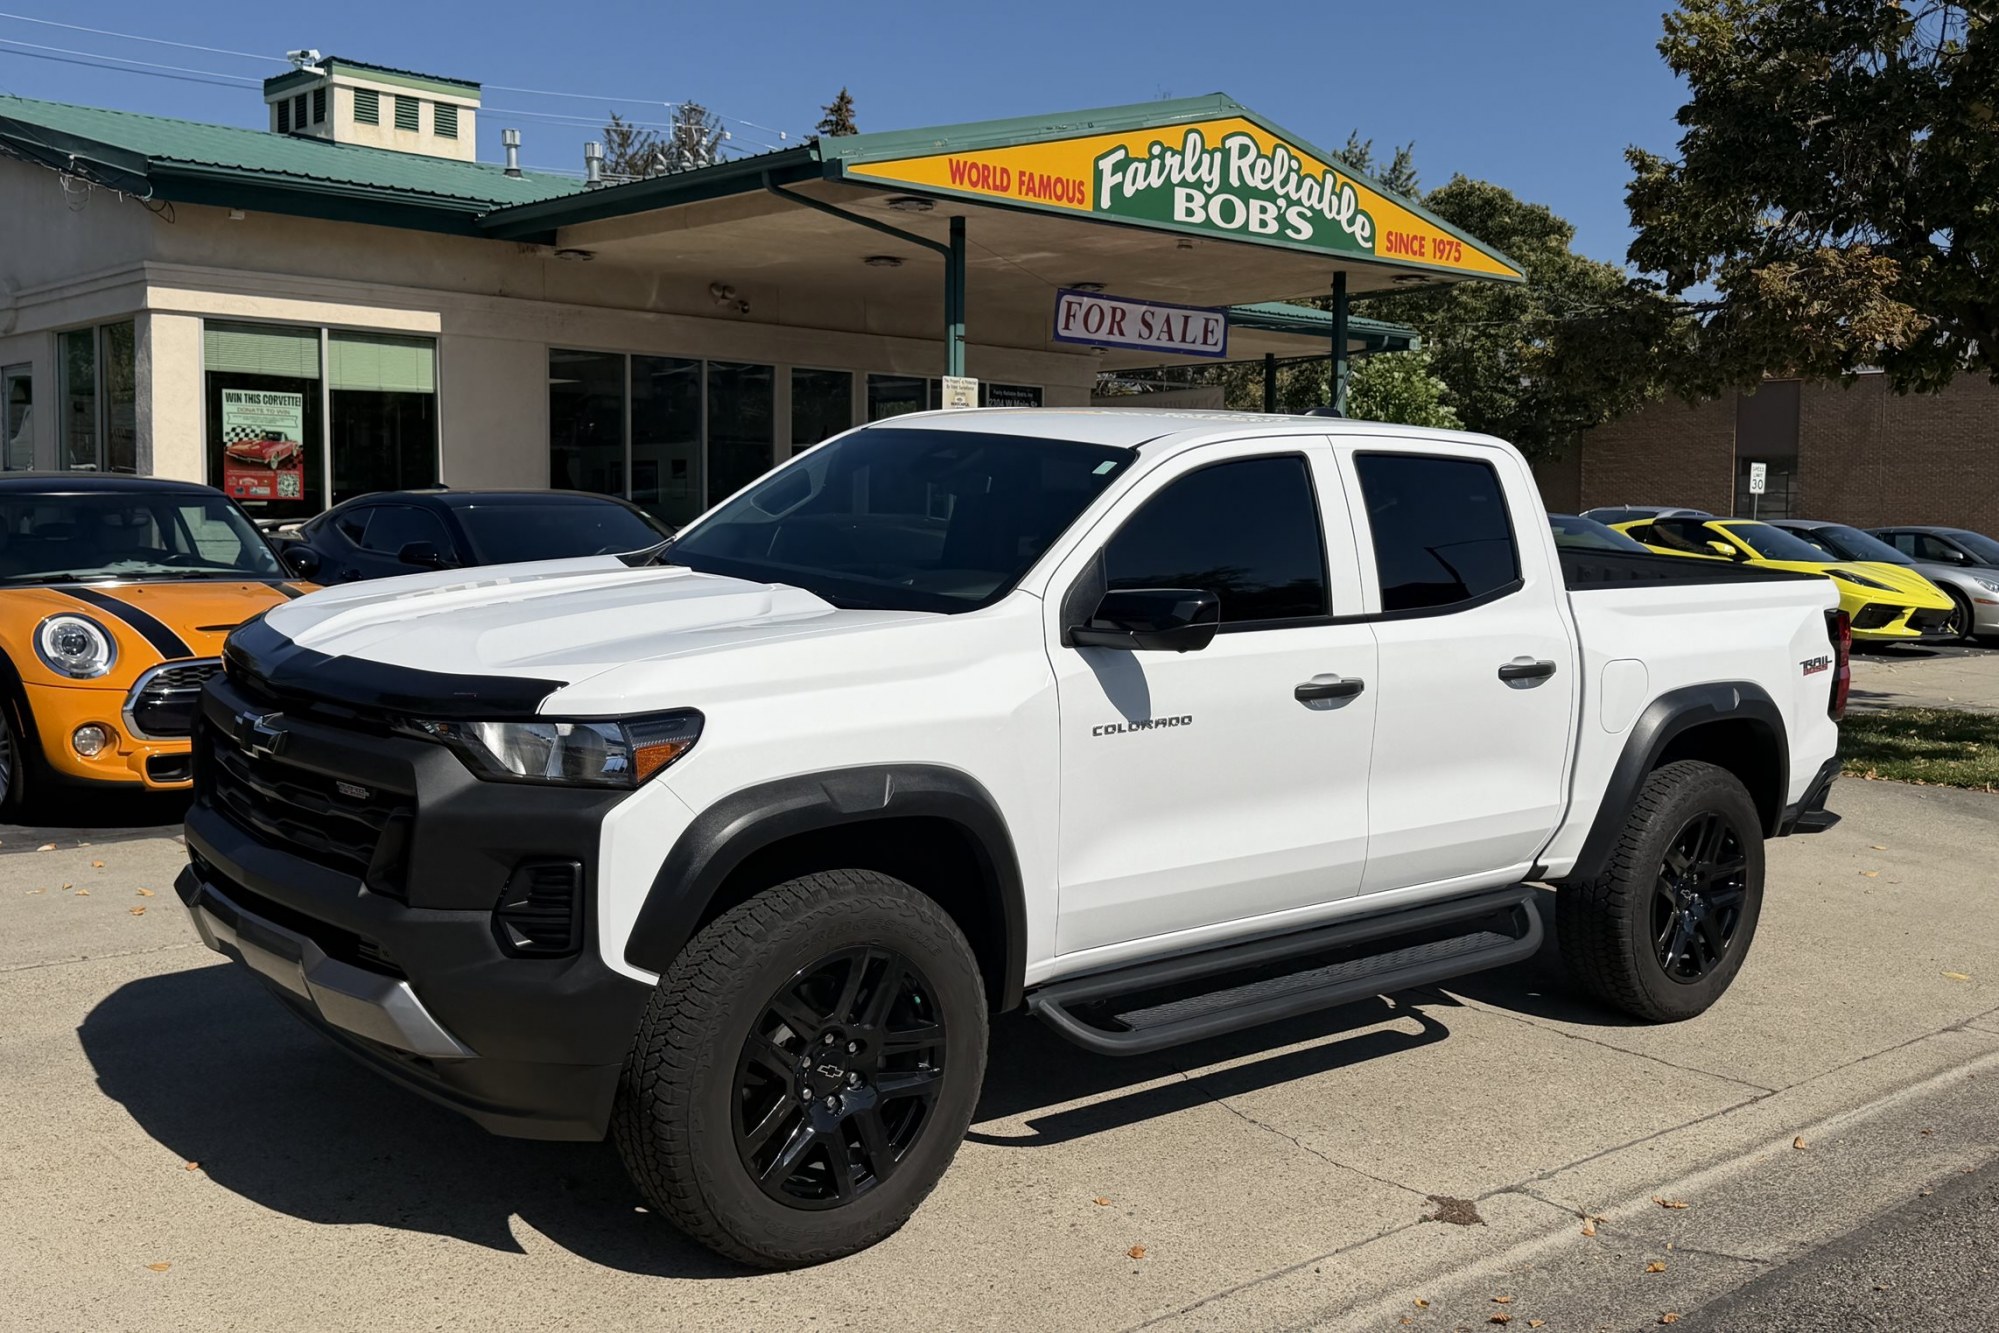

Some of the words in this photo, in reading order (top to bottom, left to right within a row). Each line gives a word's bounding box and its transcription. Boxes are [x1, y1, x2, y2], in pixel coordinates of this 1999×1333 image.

[948, 158, 1011, 193] WORLD
[1018, 170, 1086, 205] FAMOUS
[1098, 132, 1222, 209] Fairly
[1225, 135, 1373, 248] Reliable
[1174, 186, 1314, 240] BOB'S
[1385, 230, 1426, 257] SINCE
[1432, 237, 1462, 263] 1975
[1062, 300, 1127, 337] FOR
[1138, 309, 1219, 347] SALE
[225, 392, 242, 404] WIN
[244, 393, 261, 405] THIS
[262, 394, 302, 407] CORVETTE!
[1751, 479, 1763, 490] 30
[1799, 655, 1832, 669] TRAIL
[1092, 715, 1192, 737] COLORADO
